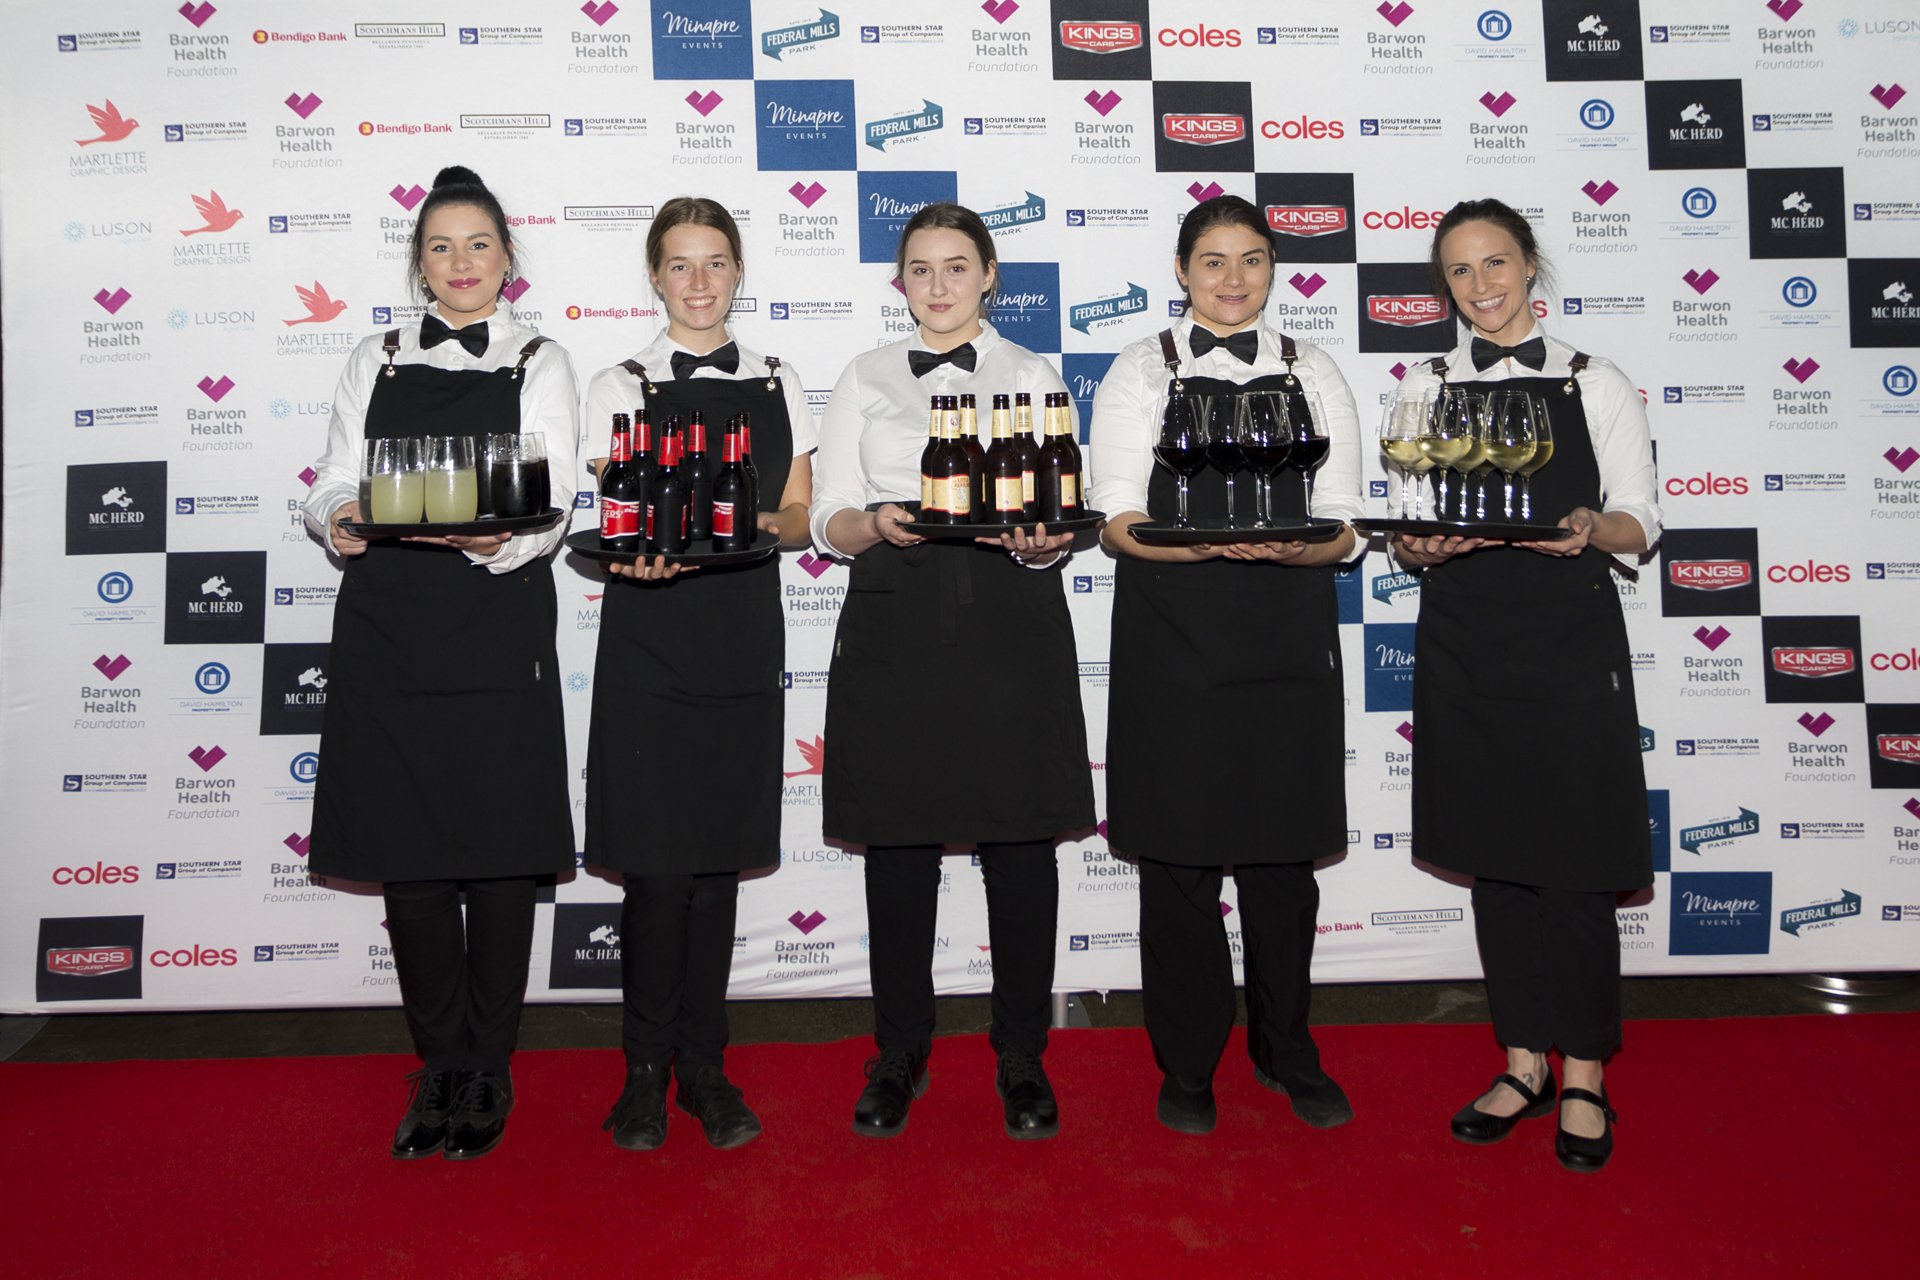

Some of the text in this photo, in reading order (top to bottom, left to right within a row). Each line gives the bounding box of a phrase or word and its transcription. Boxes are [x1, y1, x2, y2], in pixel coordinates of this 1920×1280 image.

[663, 12, 740, 37] Minapre
[271, 32, 346, 42] Bendigo Bank
[572, 32, 630, 43] Barwon
[767, 23, 836, 47] FEDERAL MILLS
[1069, 28, 1133, 39] KINGS
[1158, 24, 1241, 47] coles
[1368, 32, 1425, 44] Barwon
[1758, 28, 1815, 39] Barwon
[170, 34, 229, 45] Barwon
[576, 45, 627, 57] Health
[789, 45, 816, 54] PARK
[1589, 40, 1620, 51] HERD
[1763, 41, 1812, 53] Health
[175, 47, 226, 60] Health
[1372, 46, 1422, 58] Health
[568, 64, 638, 73] Foundation
[1364, 64, 1432, 74] Foundation
[1755, 59, 1823, 69] Foundation
[167, 66, 237, 77] Foundation
[766, 101, 844, 132] Minapre
[377, 124, 452, 134] Bendigo Bank
[870, 114, 939, 136] FEDERAL MILLS
[1075, 122, 1133, 133] Barwon
[1172, 120, 1236, 131] KINGS
[1261, 115, 1344, 139] coles
[1691, 128, 1722, 139] HERD
[892, 135, 920, 145] PARK
[1079, 136, 1130, 148] Health
[70, 152, 146, 167] MARTLETTE
[1071, 154, 1140, 164] Foundation
[1015, 206, 1041, 220] MILLS
[1274, 212, 1339, 222] KINGS
[1363, 206, 1444, 229] coles
[528, 216, 556, 224] Bank
[779, 214, 837, 225] Barwon
[1792, 217, 1824, 228] HERD
[92, 222, 151, 236] LUSON
[783, 228, 834, 240] Health
[995, 227, 1021, 237] PARK
[174, 243, 250, 257] MARTLETTE
[775, 246, 844, 256] Foundation
[1076, 297, 1143, 320] FEDERAL MILLS
[1279, 304, 1337, 315] Barwon
[1374, 301, 1442, 313] KINGS
[1673, 301, 1730, 311] Barwon
[196, 312, 254, 325] LUSON
[584, 308, 659, 319] Bendigo Bank
[1097, 318, 1124, 328] PARK
[1283, 318, 1334, 330] Health
[1677, 314, 1727, 326] Health
[84, 321, 143, 333] Barwon
[88, 333, 140, 347] Health
[277, 333, 353, 345] MARTLETTE
[1669, 332, 1738, 342] Foundation
[80, 352, 150, 364] Foundation
[1666, 472, 1748, 496] coles
[111, 512, 144, 523] HERD
[1678, 566, 1743, 577] KINGS
[1768, 560, 1850, 583] coles
[1377, 574, 1418, 590] FEDERAL
[210, 602, 243, 612] HERD
[1781, 653, 1846, 664] KINGS
[81, 687, 140, 698] Barwon
[85, 700, 136, 713] Health
[74, 719, 145, 729] Foundation
[1789, 742, 1847, 753] Barwon
[1793, 755, 1845, 767] Health
[1785, 772, 1856, 781] Foundation
[176, 778, 235, 789] Barwon
[178, 791, 230, 803] Health
[168, 809, 239, 819] Foundation
[1685, 821, 1755, 842] FEDERAL MILLS
[1708, 840, 1734, 849] PARK
[53, 861, 139, 885] coles
[1682, 891, 1759, 917] Minapre
[1786, 902, 1857, 924] FEDERAL MILLS
[1335, 922, 1363, 931] Bank
[1807, 922, 1835, 931] PARK
[775, 941, 834, 951] Barwon
[56, 952, 124, 964] KINGS
[150, 944, 237, 967] coles
[778, 952, 829, 963] Health
[766, 968, 838, 981] Foundation
